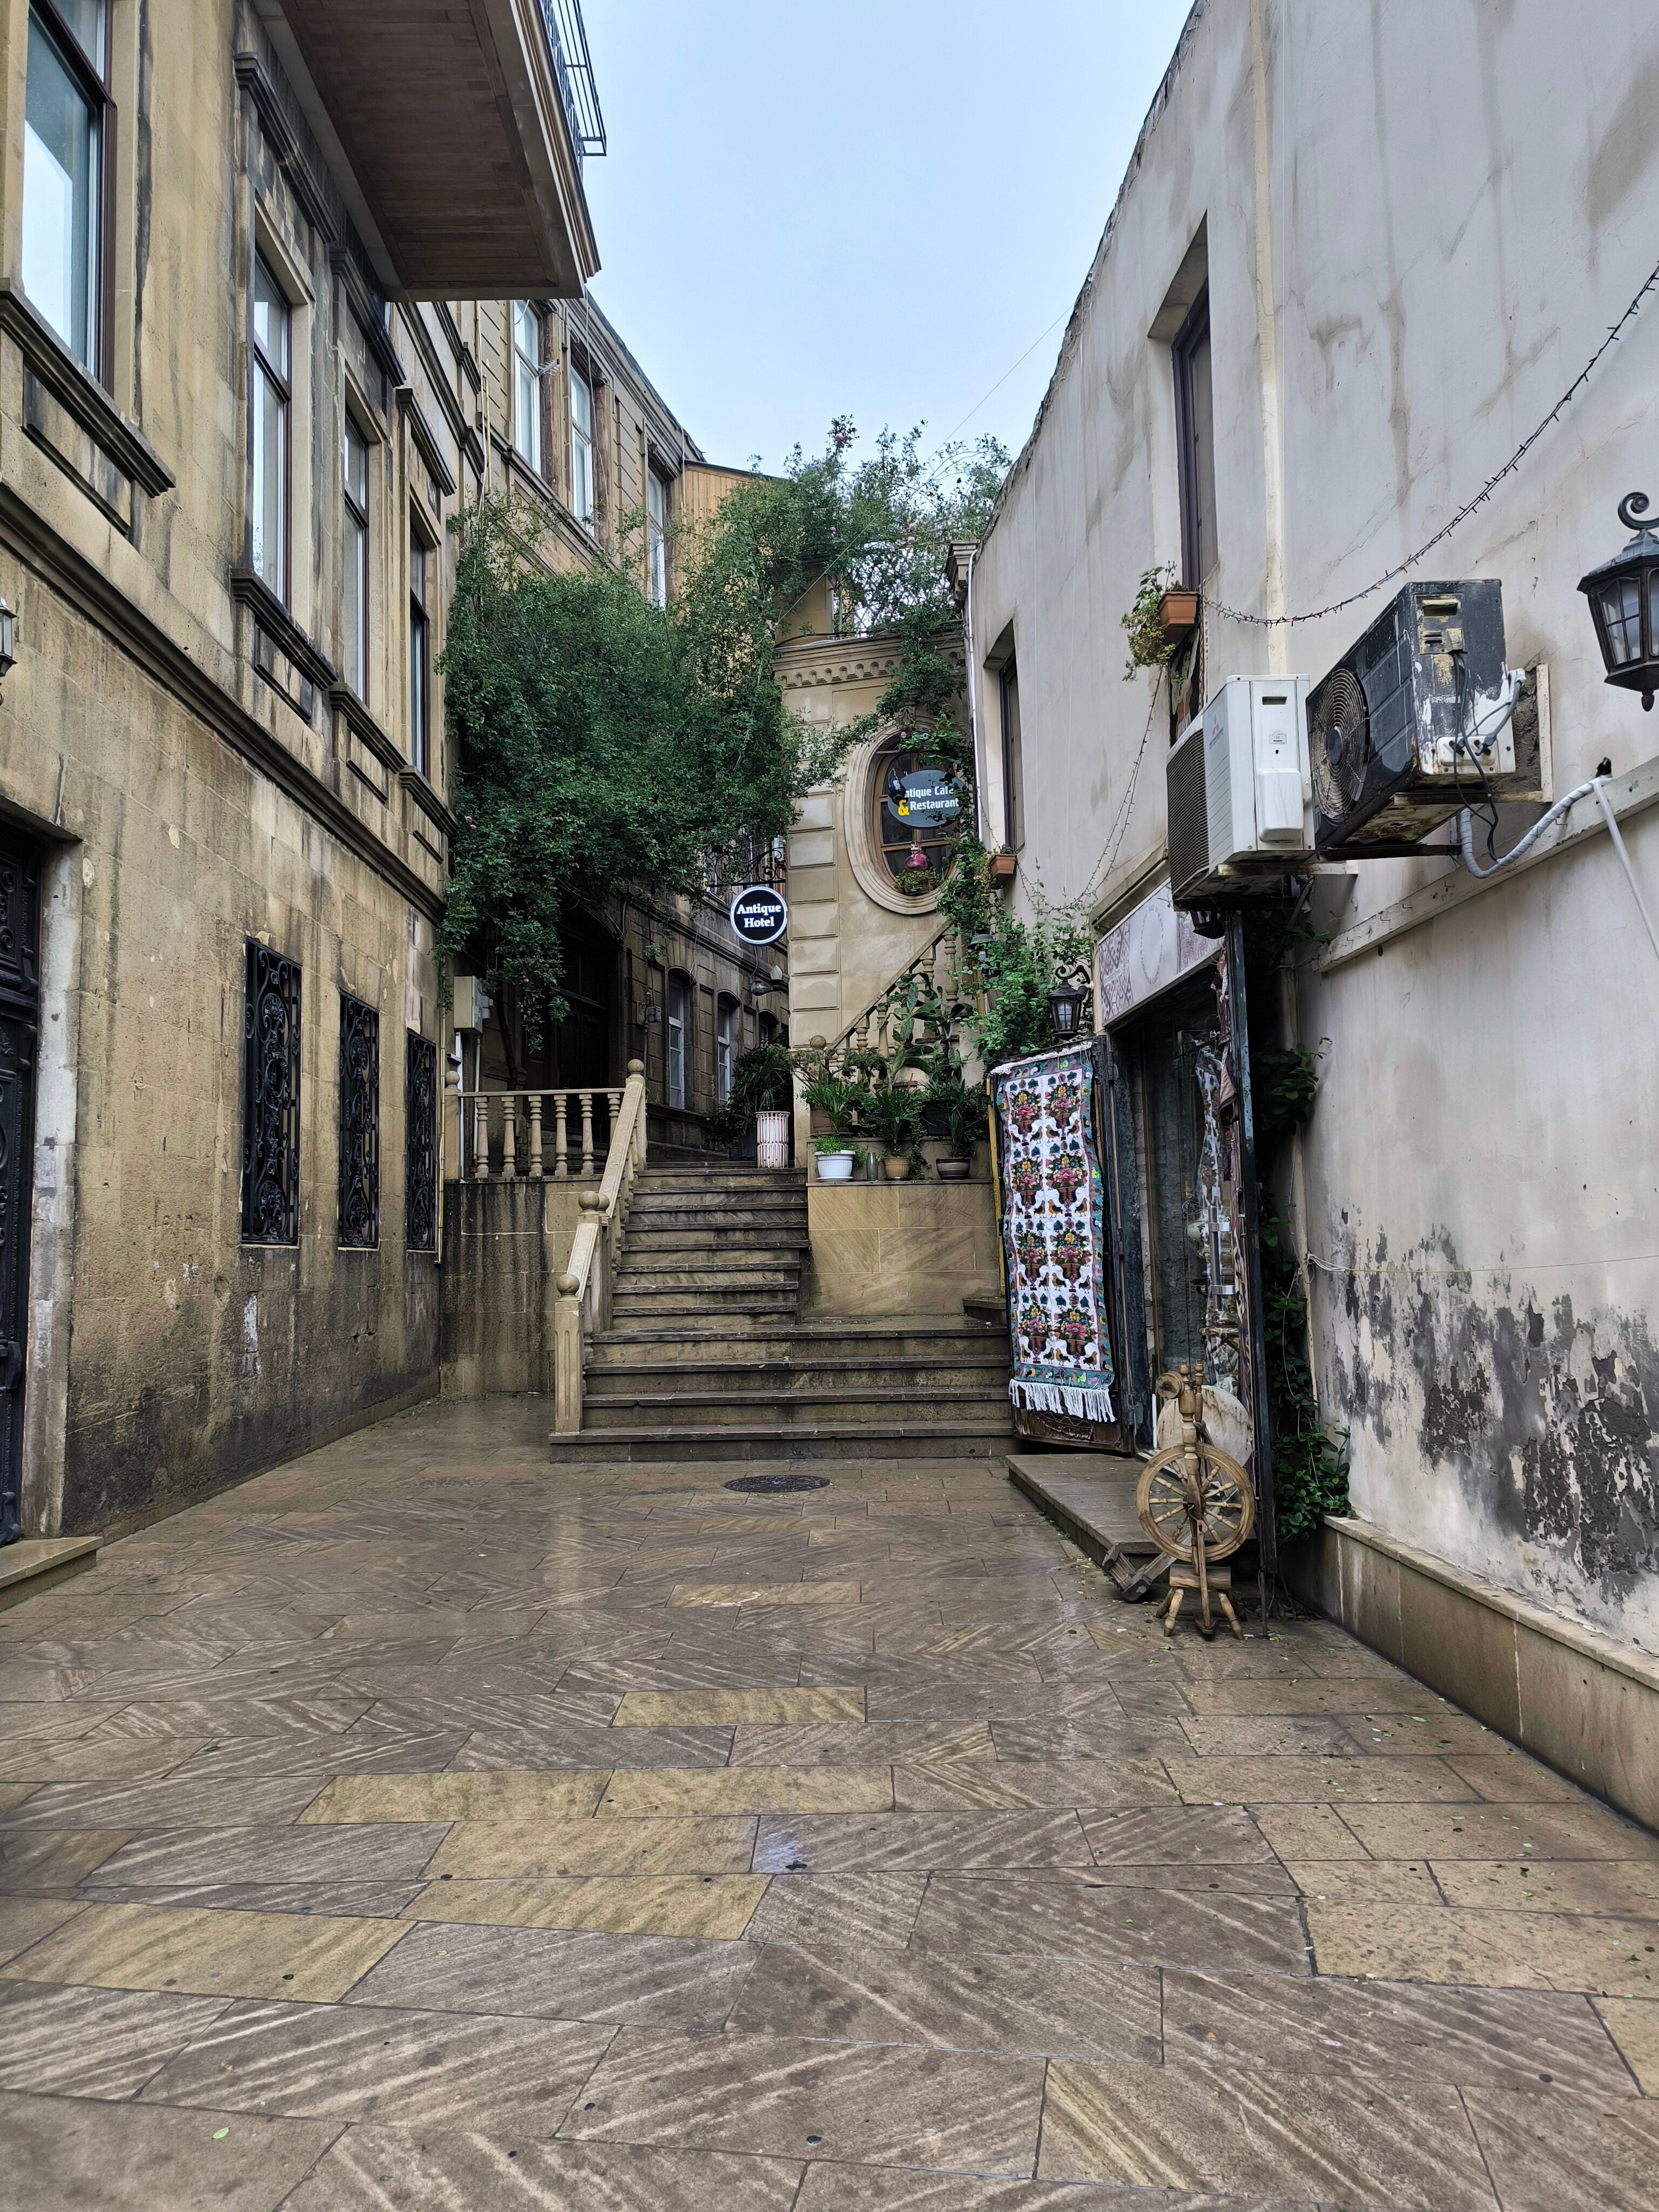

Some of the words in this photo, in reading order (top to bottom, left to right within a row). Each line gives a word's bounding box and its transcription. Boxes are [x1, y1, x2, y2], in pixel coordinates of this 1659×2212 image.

[904, 788, 932, 798] ntique
[898, 799, 910, 815] &
[910, 798, 959, 811] Restaurant
[736, 903, 781, 916] Antique
[744, 916, 775, 928] Hotel
